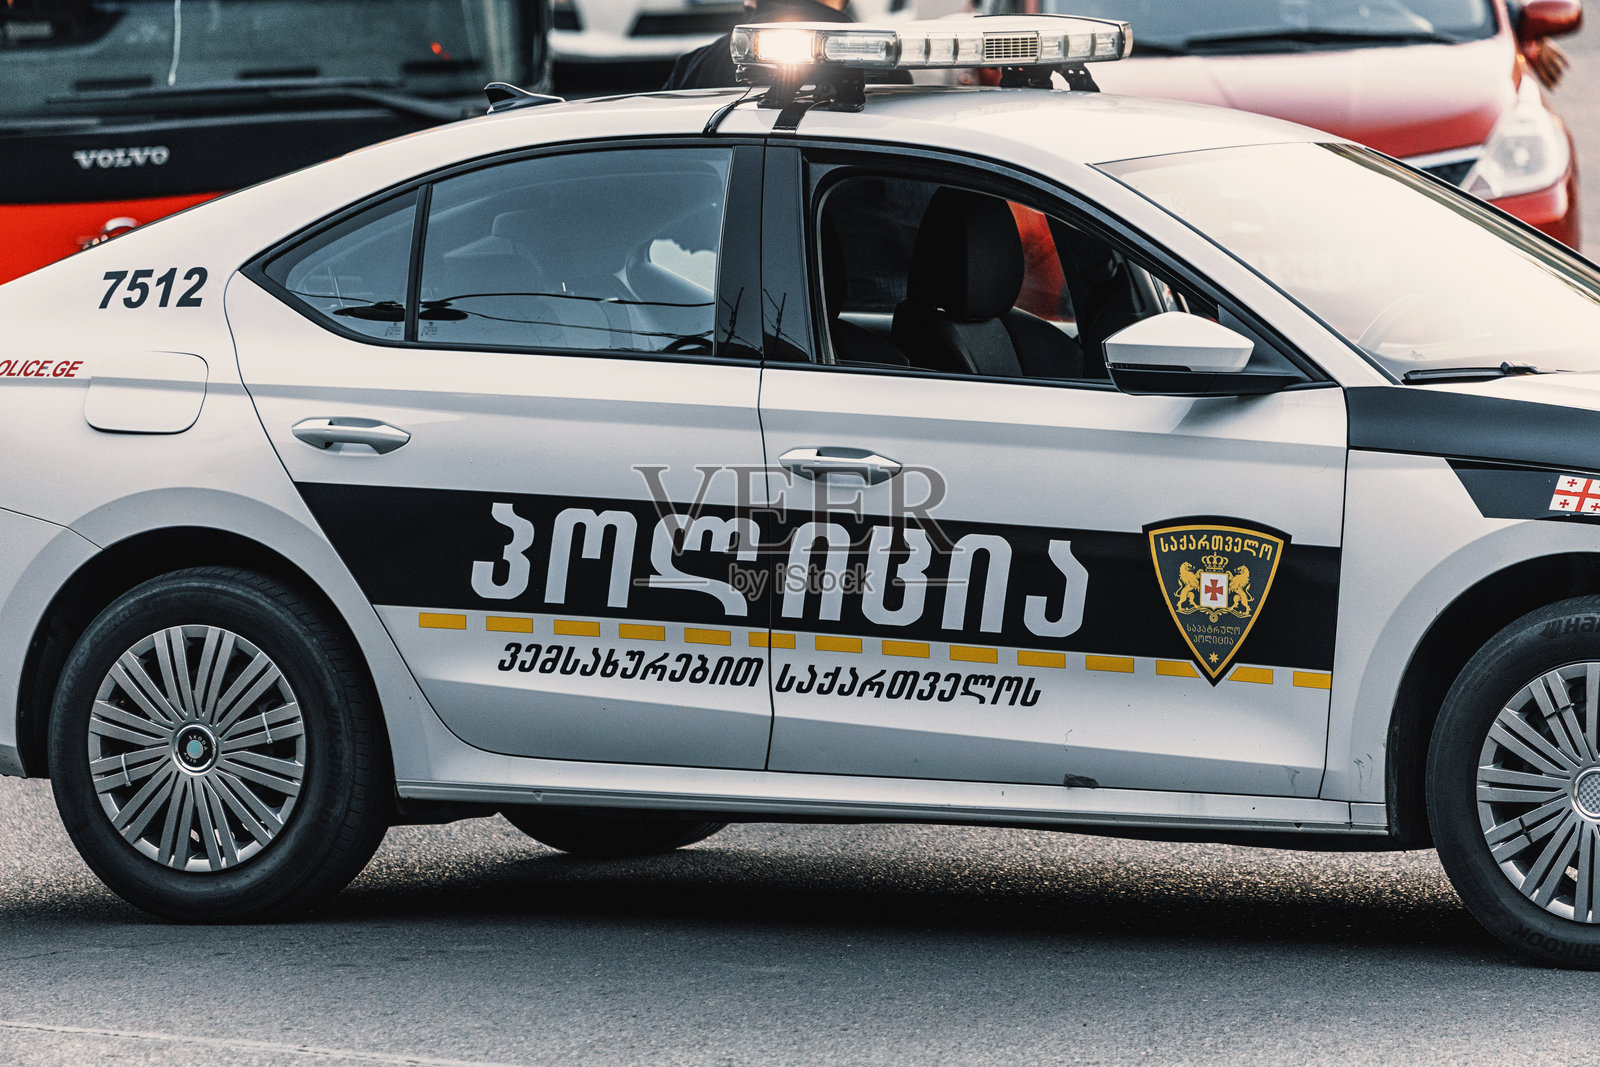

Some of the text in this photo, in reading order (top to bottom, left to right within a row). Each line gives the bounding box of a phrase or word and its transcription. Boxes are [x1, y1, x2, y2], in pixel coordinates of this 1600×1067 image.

[73, 145, 170, 169] VOLVO
[98, 266, 208, 309] 7512
[1159, 534, 1273, 561] საქართველო
[470, 502, 1090, 638] პოლიცია
[1193, 634, 1235, 646] პოლიცია
[497, 642, 1042, 707] ვემსახურებით საქართველოს
